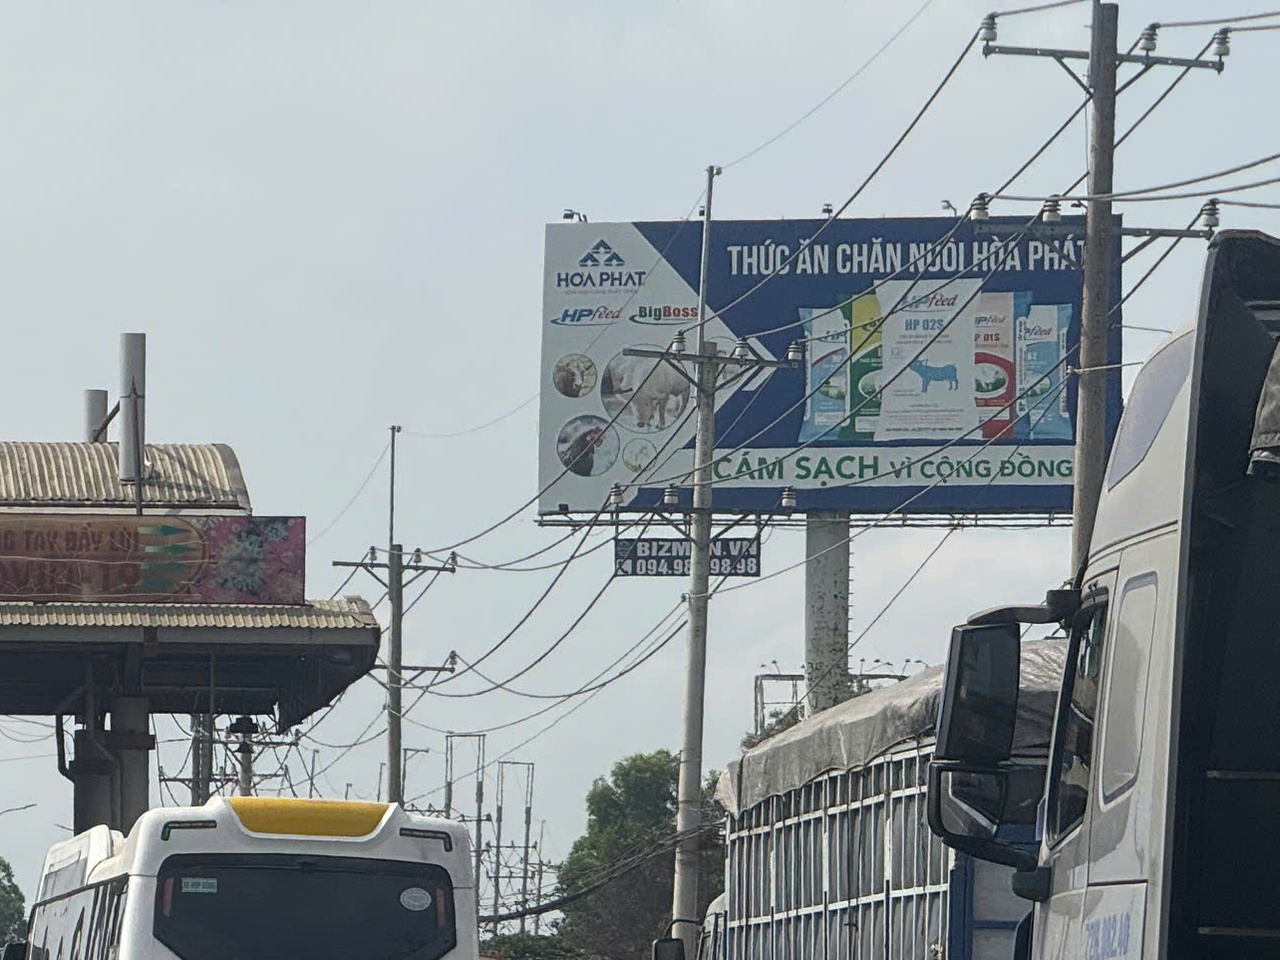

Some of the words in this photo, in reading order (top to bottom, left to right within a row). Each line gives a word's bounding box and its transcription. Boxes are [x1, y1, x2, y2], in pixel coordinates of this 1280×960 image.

[727, 238, 790, 276] THỨC
[796, 236, 831, 275] ĂN
[837, 236, 902, 274] CHĂN
[909, 235, 965, 273] NUÔI
[973, 235, 1022, 271] HÒA
[638, 305, 699, 321] BigBoss
[904, 319, 920, 331] HP
[922, 319, 944, 331] 02S
[713, 451, 785, 480] CÁM
[795, 455, 879, 487] SẠCH
[890, 456, 913, 478] VÌ
[920, 455, 992, 484] CỘNG
[1000, 452, 1074, 478] ĐỒNG
[637, 541, 758, 557] BIZMN.VN
[637, 558, 757, 574] 094.9898.98
